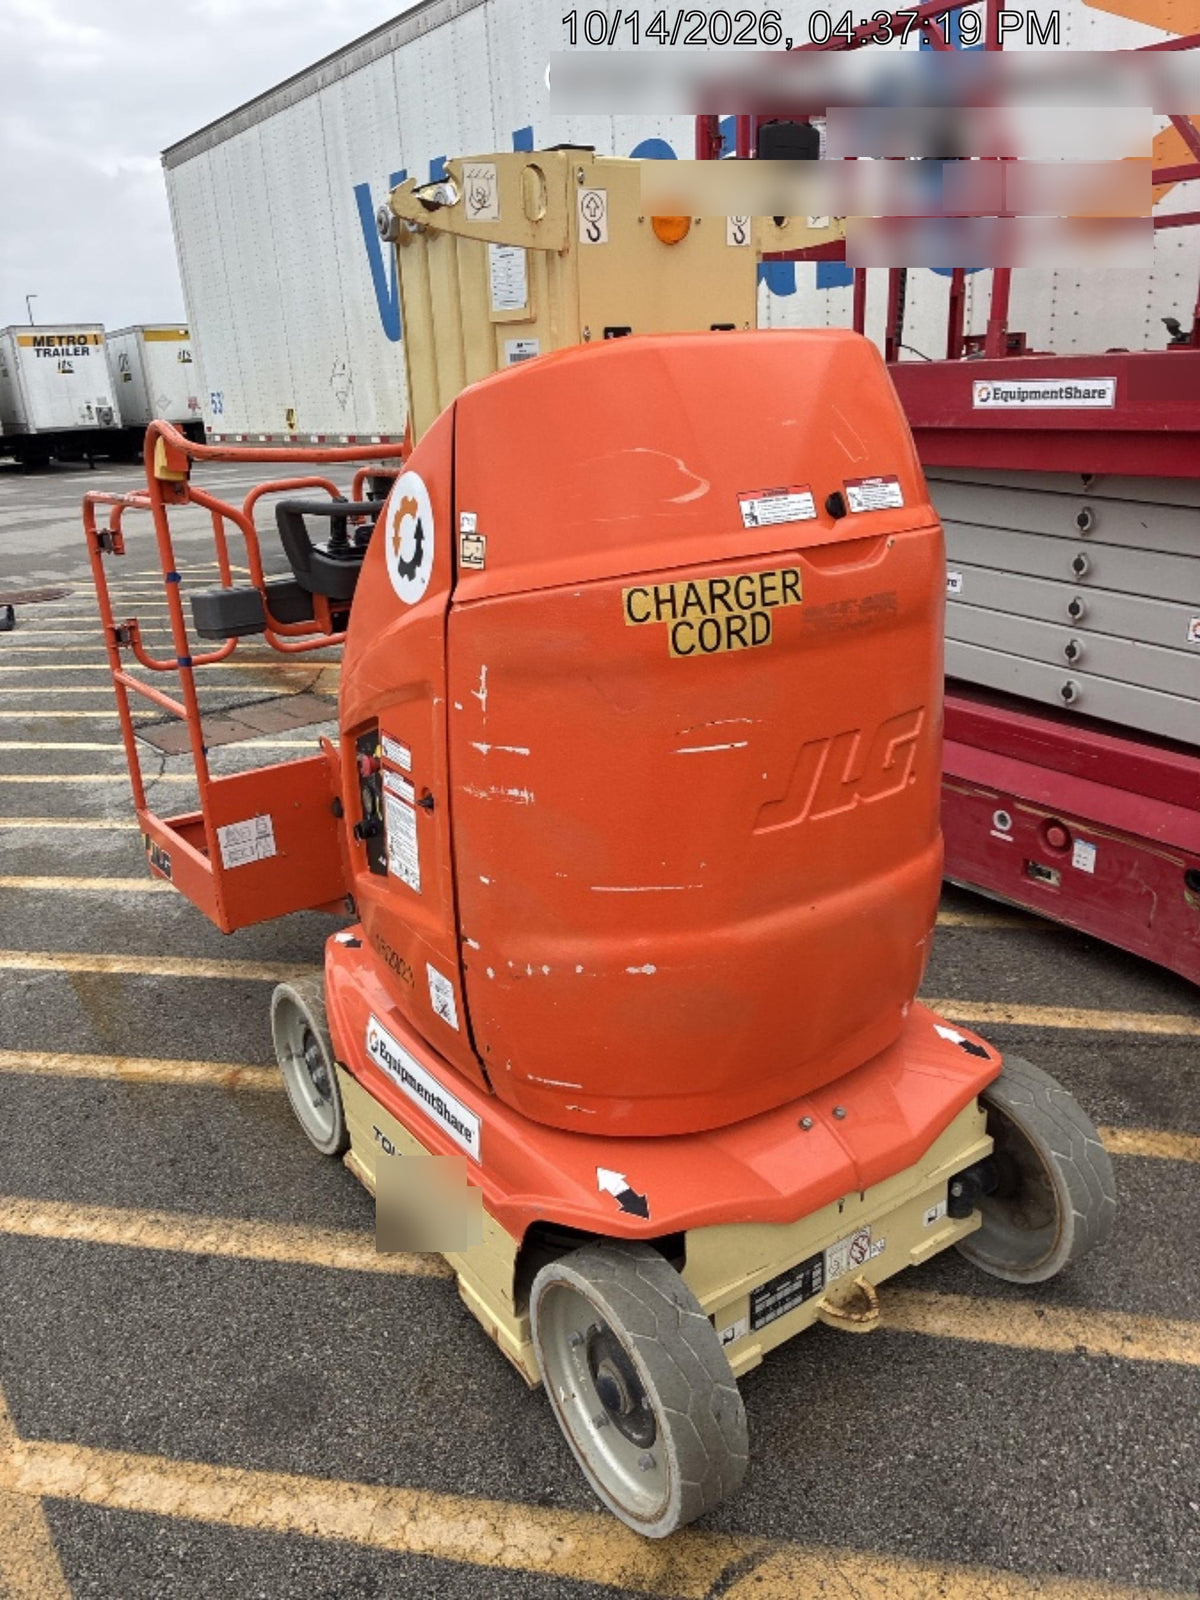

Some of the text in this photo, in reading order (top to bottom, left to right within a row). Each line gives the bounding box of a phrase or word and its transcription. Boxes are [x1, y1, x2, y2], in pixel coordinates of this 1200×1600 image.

[33, 334, 88, 347] METRO
[35, 346, 90, 358] TRAILER
[992, 387, 1108, 402] EquipmentShare
[626, 568, 803, 624] CHARGER
[671, 611, 772, 656] CORD
[752, 704, 926, 836] JLG
[380, 1040, 473, 1144] EquipmentShare
